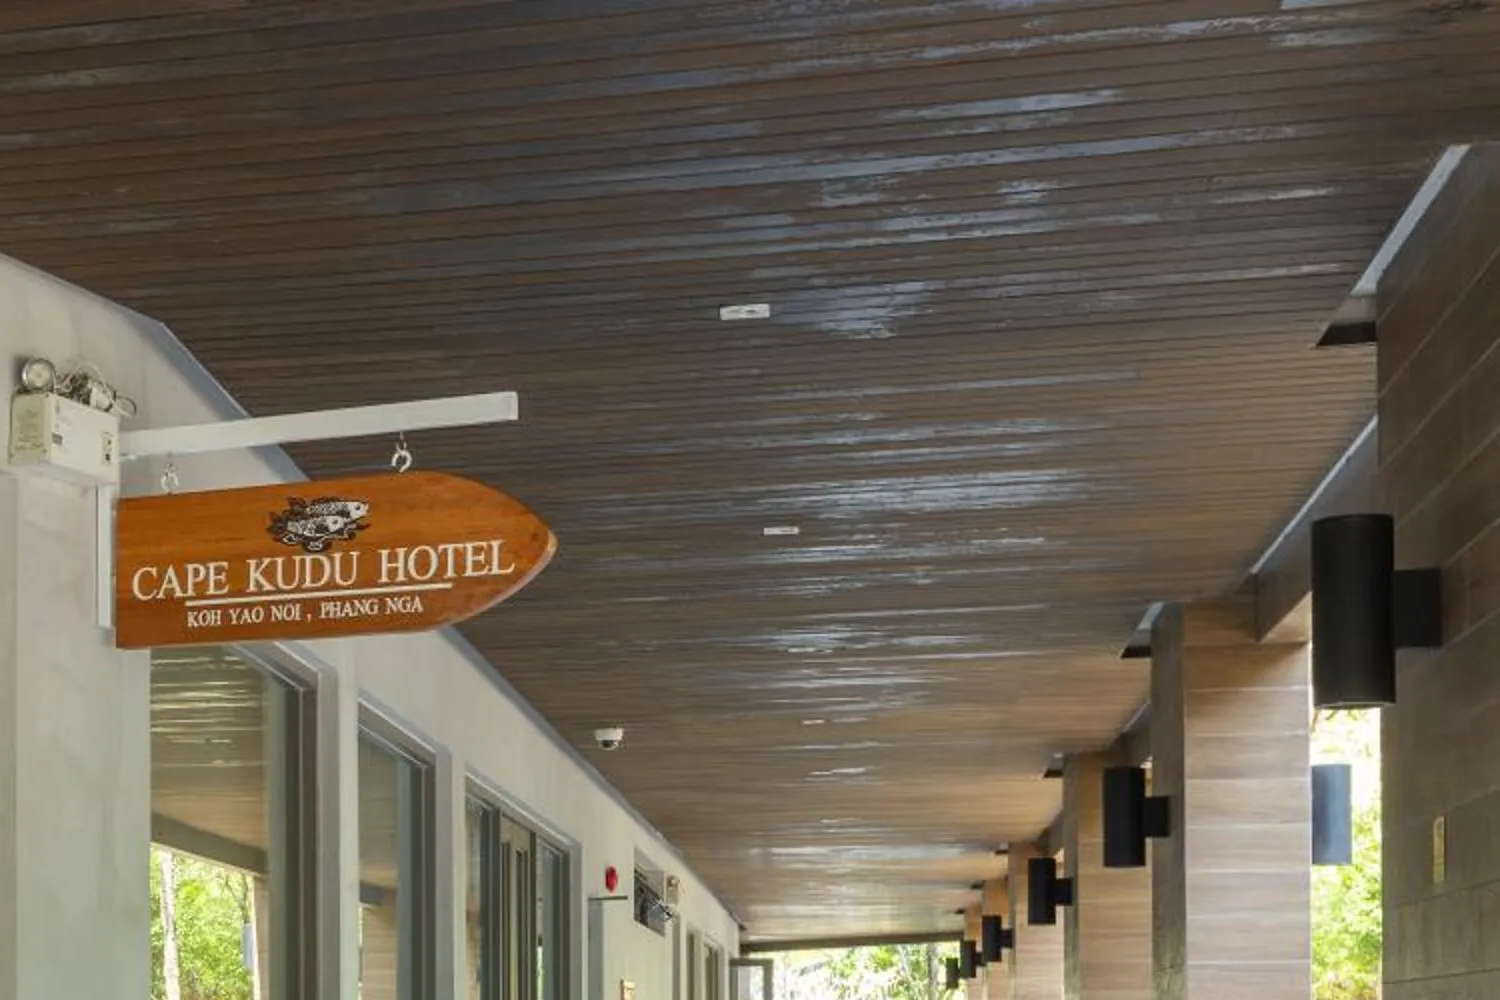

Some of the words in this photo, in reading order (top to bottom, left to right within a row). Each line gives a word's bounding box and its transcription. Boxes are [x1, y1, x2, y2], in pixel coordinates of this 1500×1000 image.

[131, 561, 230, 601] CAPE
[246, 551, 361, 593] KUDU
[377, 539, 516, 584] HOTEL
[187, 609, 222, 628] KOH
[229, 606, 265, 625] YAO
[319, 598, 379, 620] PHANG
[385, 595, 425, 615] NGA
